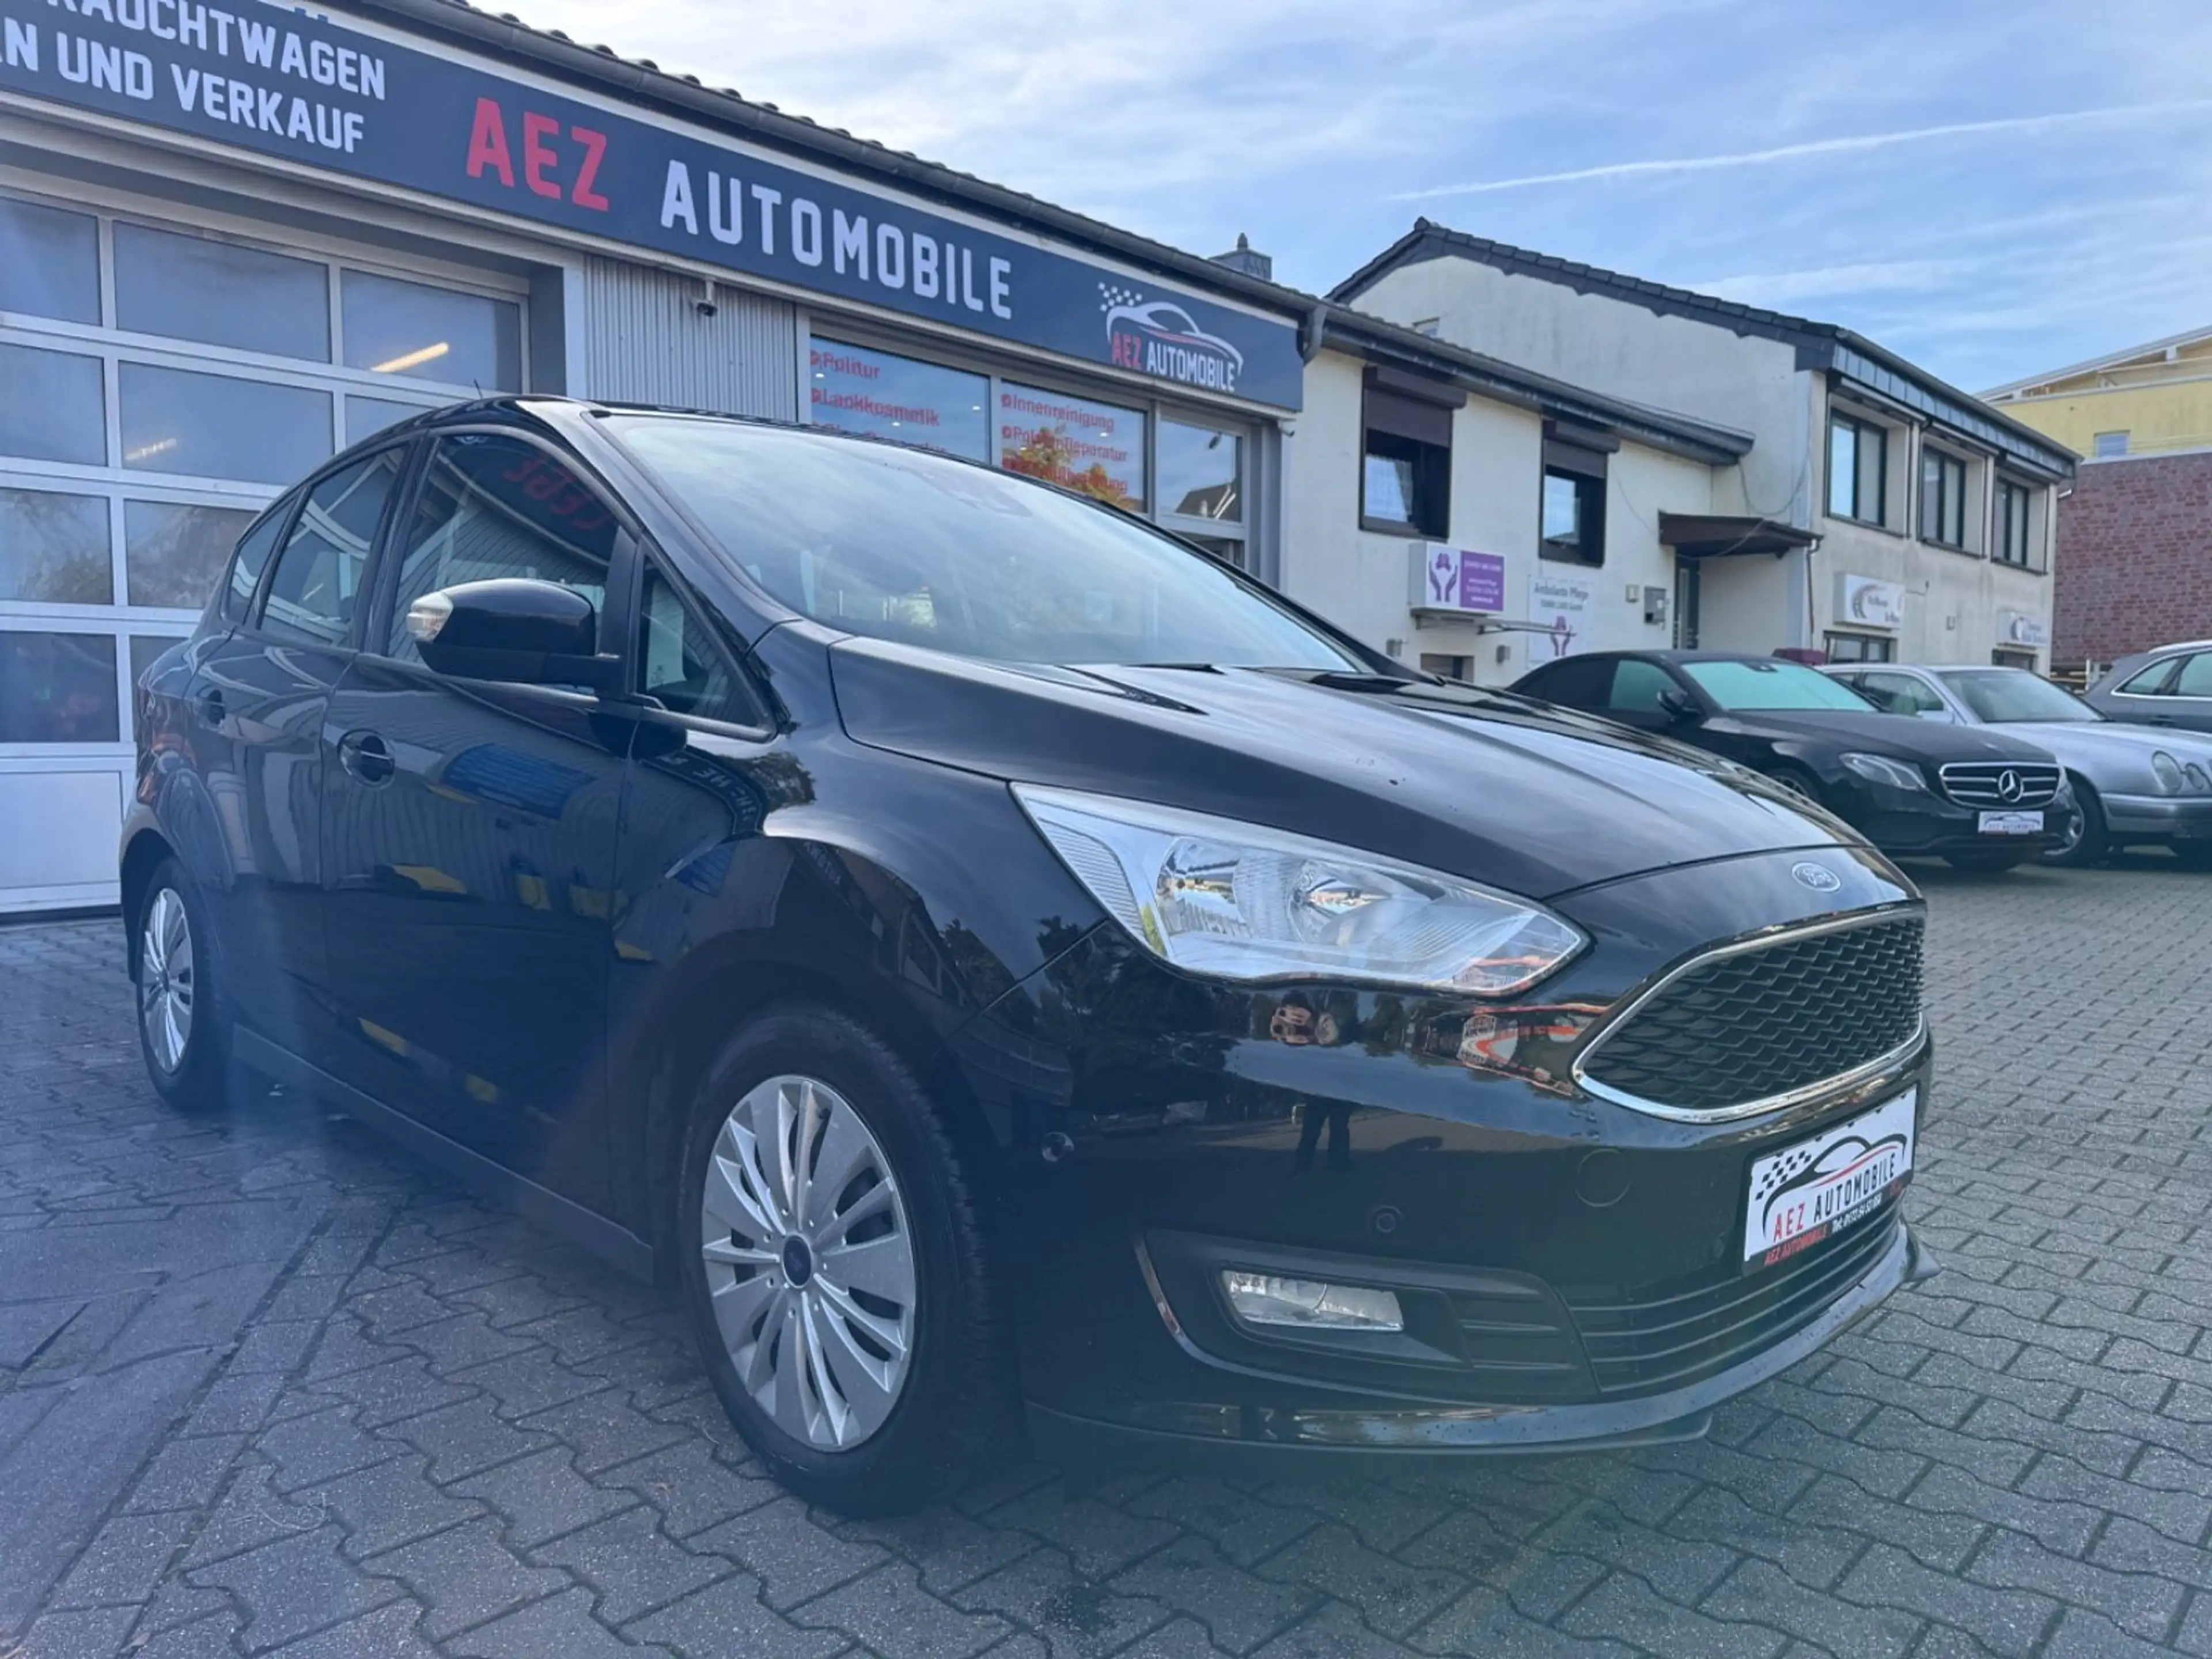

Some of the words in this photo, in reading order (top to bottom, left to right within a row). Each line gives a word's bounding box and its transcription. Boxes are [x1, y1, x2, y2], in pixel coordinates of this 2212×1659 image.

[0, 18, 38, 71] N
[57, 31, 154, 101] UND
[171, 63, 364, 154] VERKAUF
[40, 0, 385, 101] UCHTWAGEN
[465, 97, 609, 212] AEZ
[660, 159, 1012, 320] AUTOMOBILE
[823, 352, 880, 378] Politur
[1112, 331, 1142, 370] AEZ
[1146, 341, 1235, 392] AUTOMOBILE
[1014, 395, 1115, 433] Innenreinigung
[1774, 1203, 1805, 1243] AEZ
[1814, 1153, 1896, 1223] AUTOMOBILE
